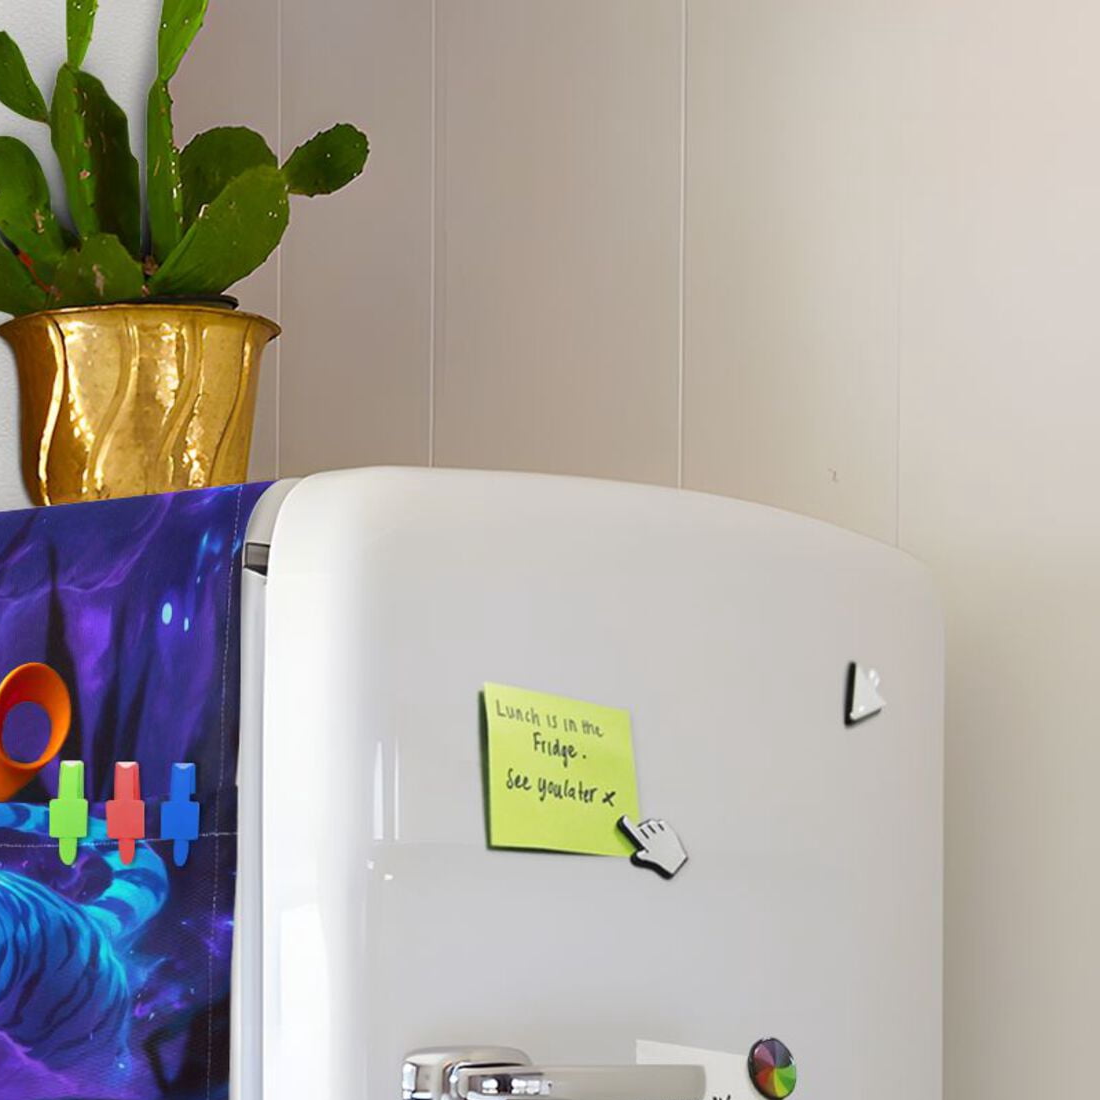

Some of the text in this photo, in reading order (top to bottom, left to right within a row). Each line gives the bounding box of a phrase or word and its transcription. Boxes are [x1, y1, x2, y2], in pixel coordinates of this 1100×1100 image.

[496, 699, 540, 727] Lunch
[581, 719, 604, 738] the
[506, 768, 532, 790] See
